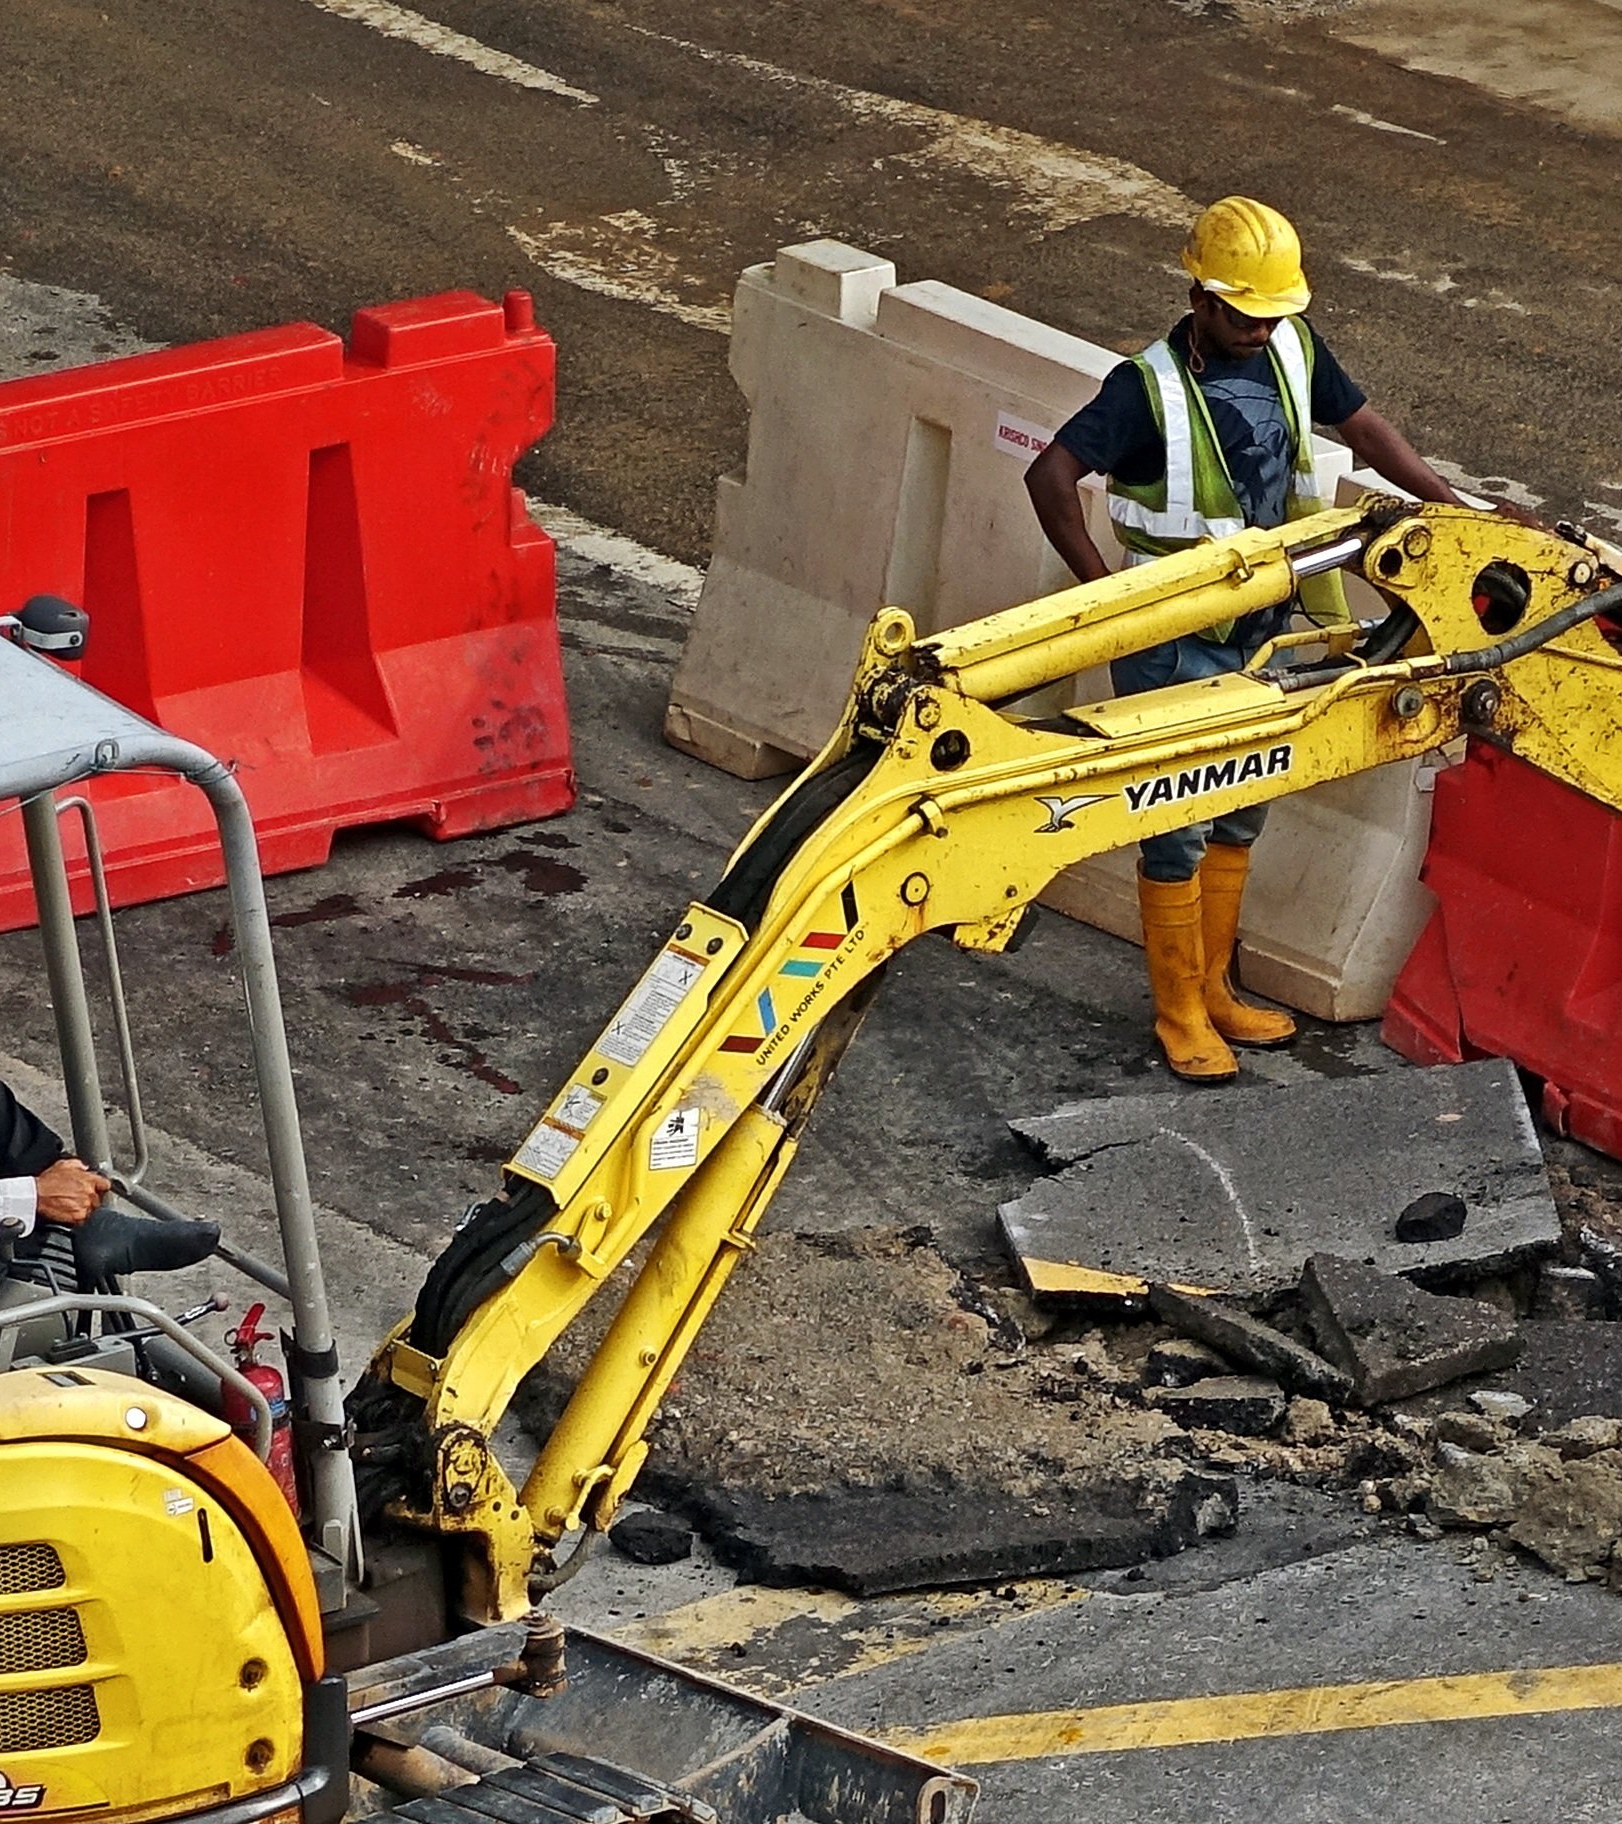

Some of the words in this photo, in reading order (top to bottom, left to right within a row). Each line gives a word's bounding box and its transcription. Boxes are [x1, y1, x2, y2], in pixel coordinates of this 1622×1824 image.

[14, 411, 59, 439] NOT
[66, 408, 81, 427] A
[90, 387, 179, 423] SAFETY
[186, 365, 283, 400] BARRIER
[1124, 745, 1292, 811] YANMAR
[756, 1024, 790, 1066] UNITED
[789, 981, 825, 1023] WORKS
[824, 954, 845, 979] PTE
[844, 929, 865, 954] LTD
